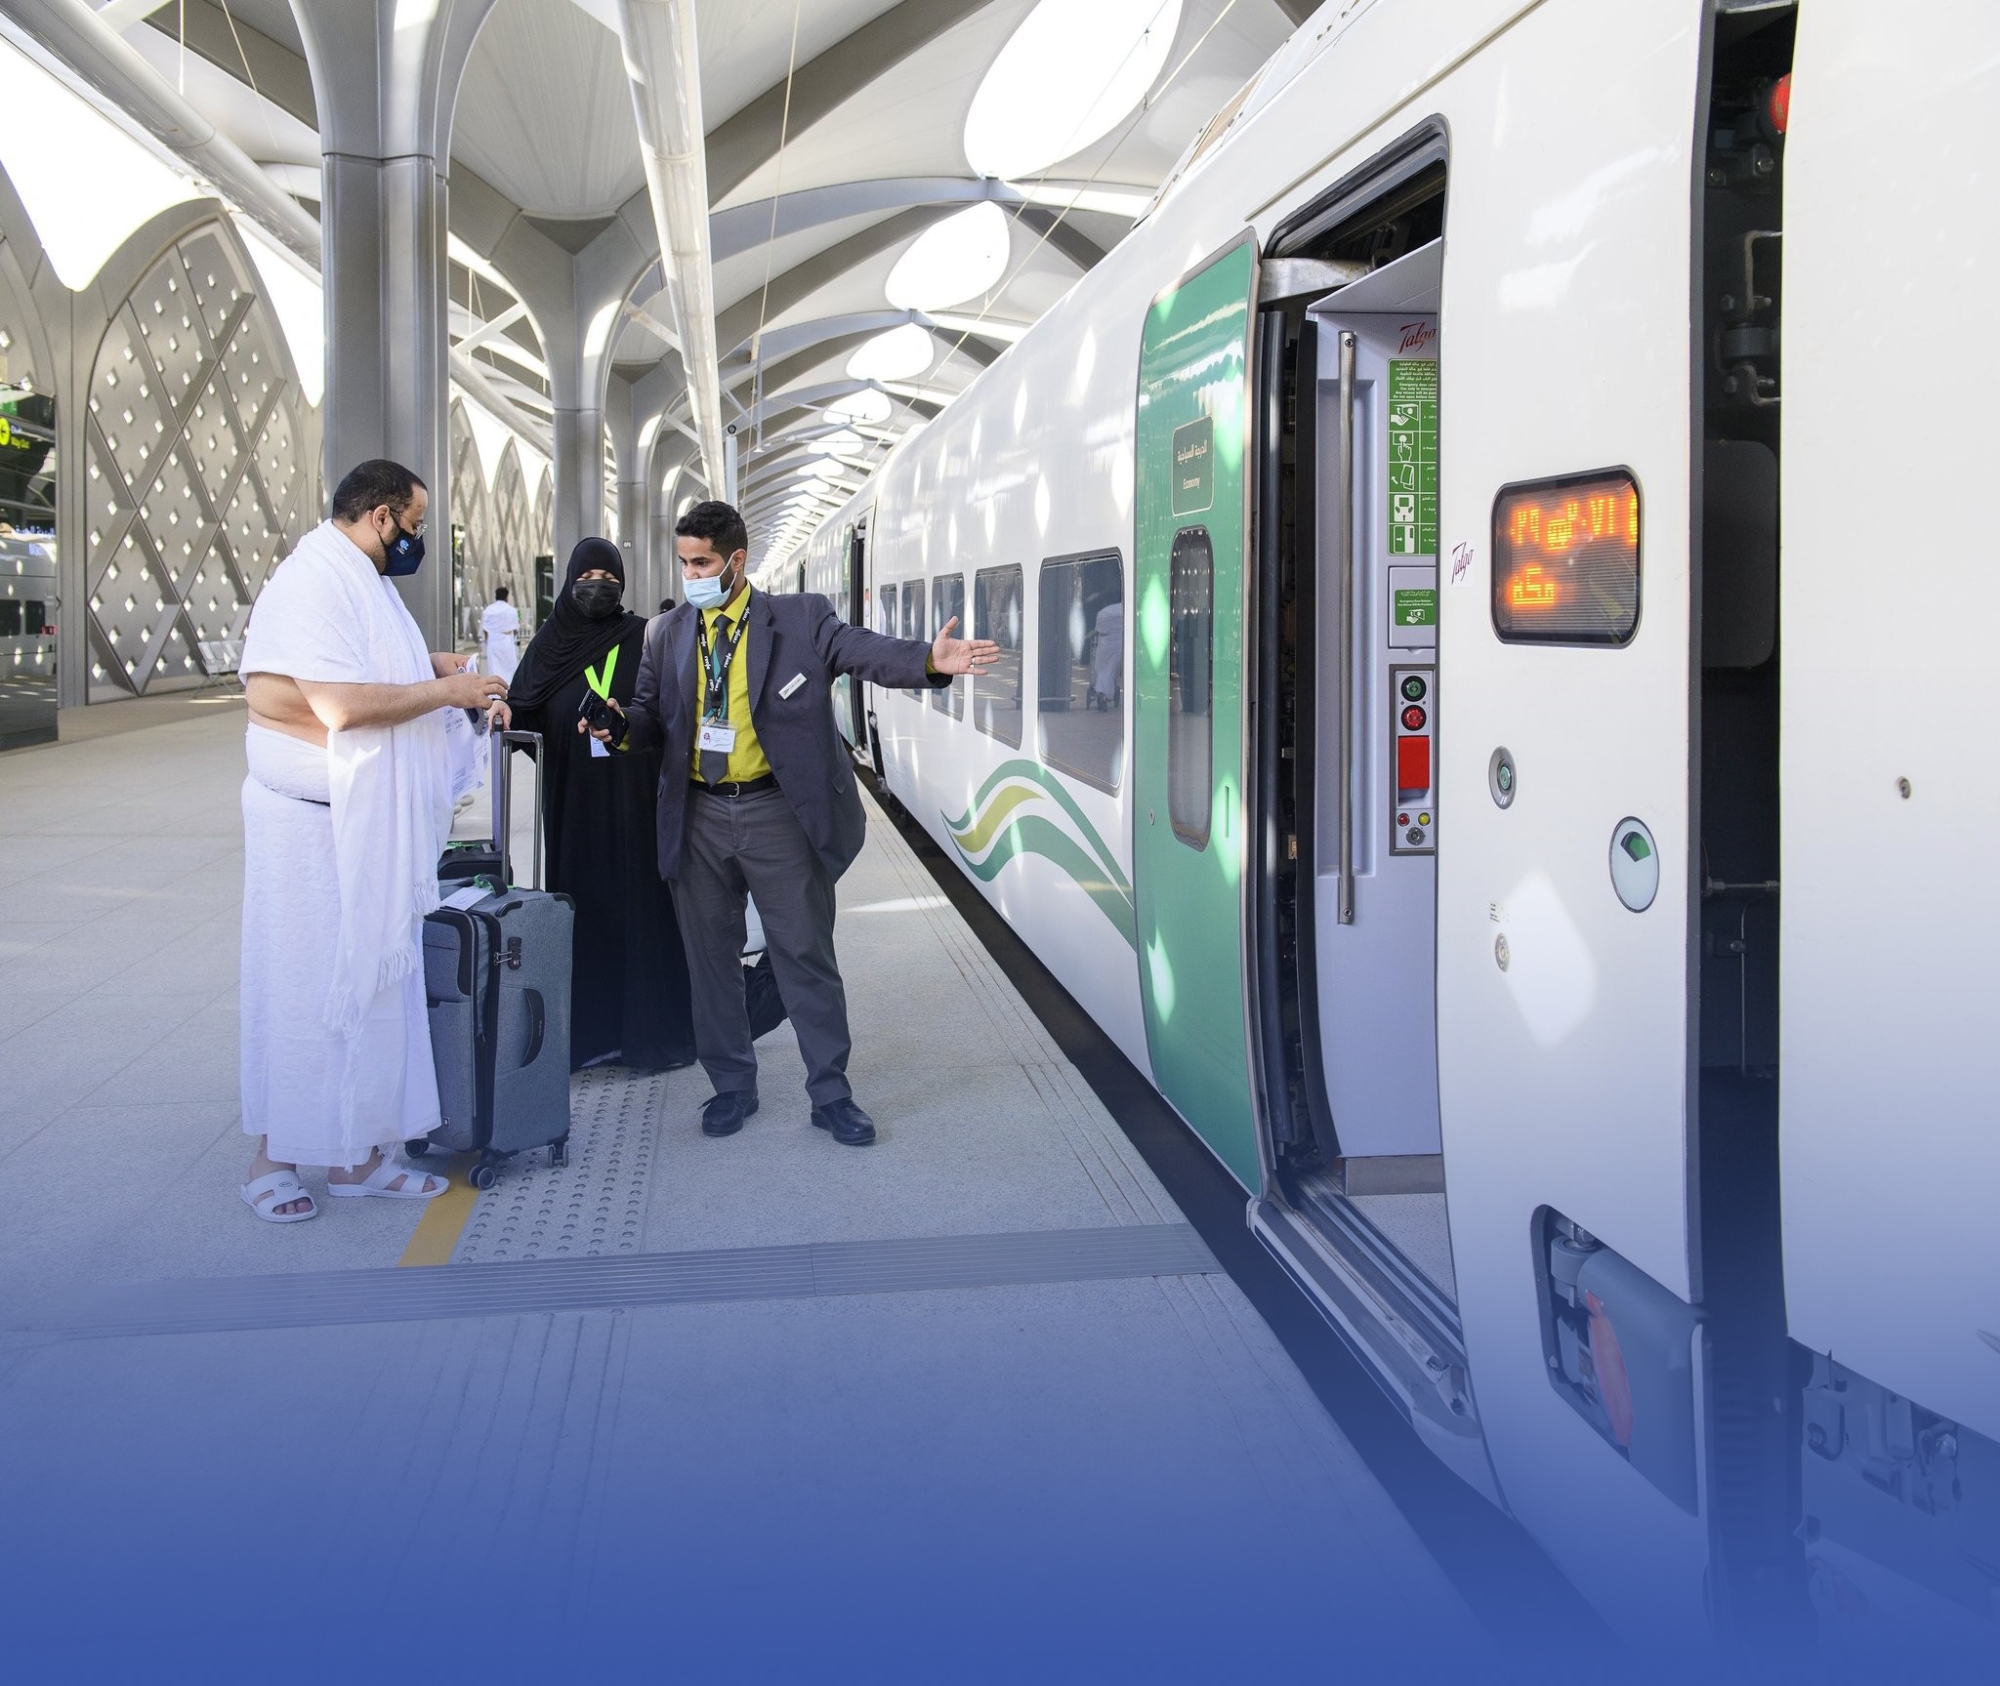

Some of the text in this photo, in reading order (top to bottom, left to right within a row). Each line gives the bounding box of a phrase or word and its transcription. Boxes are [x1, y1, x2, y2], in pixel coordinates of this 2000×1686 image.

[1399, 322, 1437, 354] Talgo
[1183, 477, 1200, 490] Economy
[1451, 541, 1474, 585] Talgo
